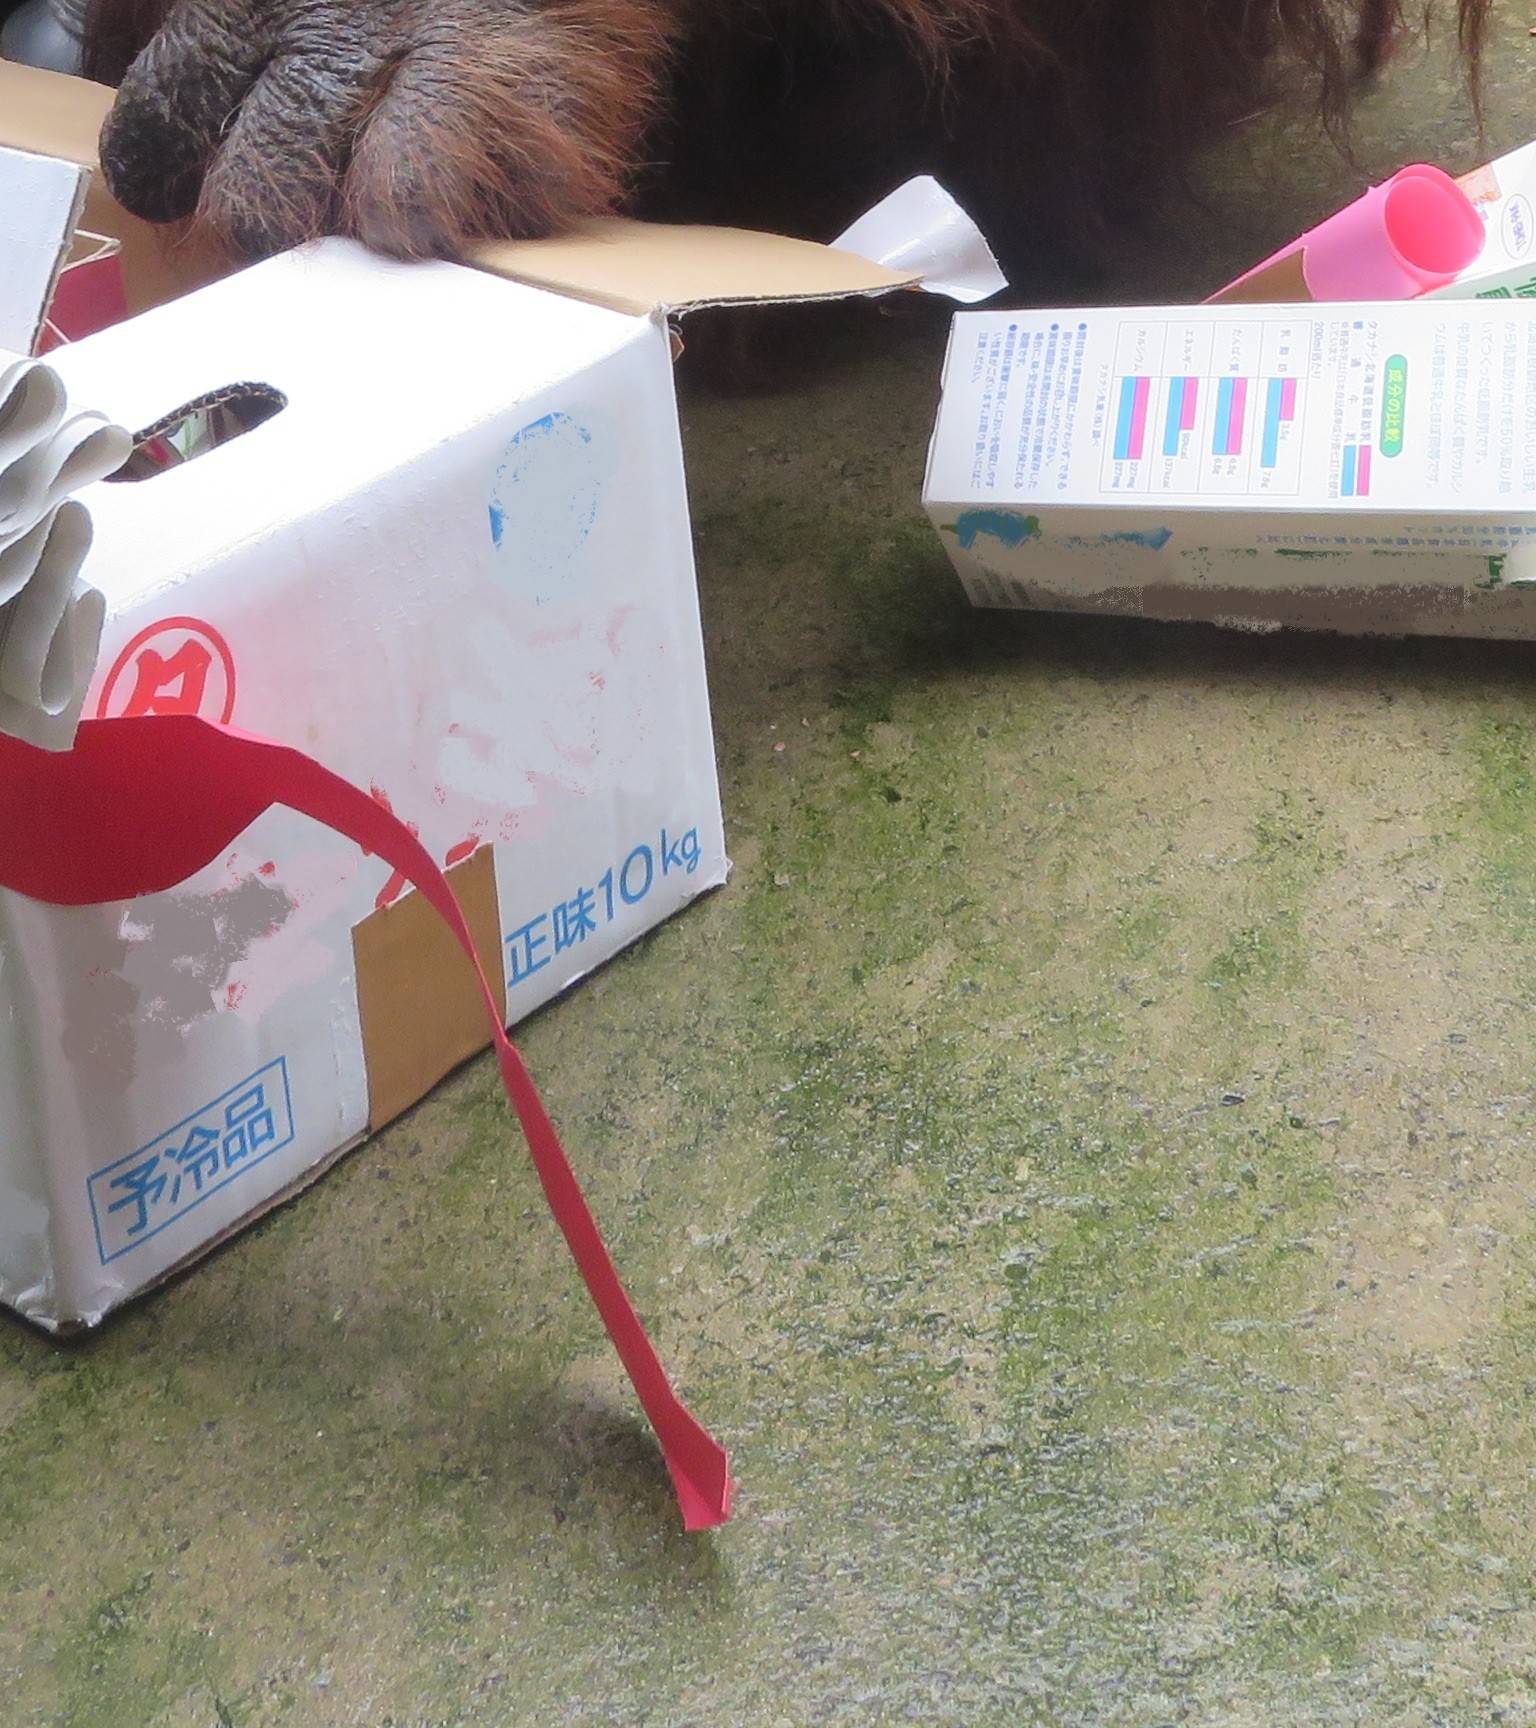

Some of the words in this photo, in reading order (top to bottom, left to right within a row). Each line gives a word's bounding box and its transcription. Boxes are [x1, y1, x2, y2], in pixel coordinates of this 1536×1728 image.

[504, 825, 703, 989] 正味10kg
[107, 1081, 277, 1239] 予冷品
